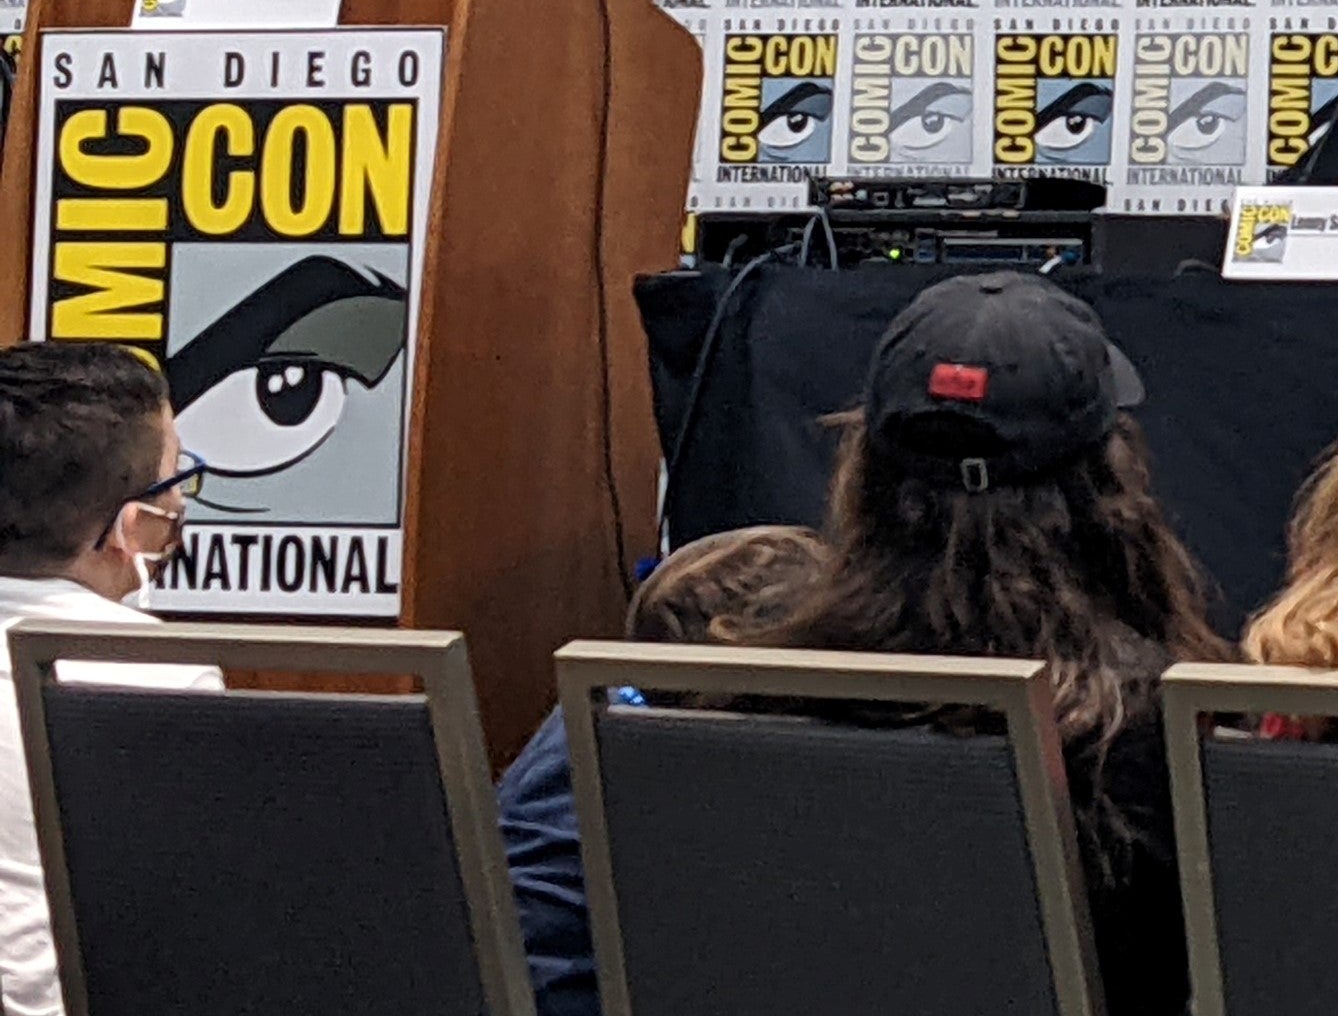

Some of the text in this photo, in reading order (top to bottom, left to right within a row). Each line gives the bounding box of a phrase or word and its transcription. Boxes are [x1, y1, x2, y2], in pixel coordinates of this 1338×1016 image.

[53, 49, 420, 90] SAN DIEGO
[181, 103, 412, 237] CON
[51, 106, 174, 371] MIC
[1258, 206, 1291, 223] CON
[155, 533, 400, 595] NATIONAL
